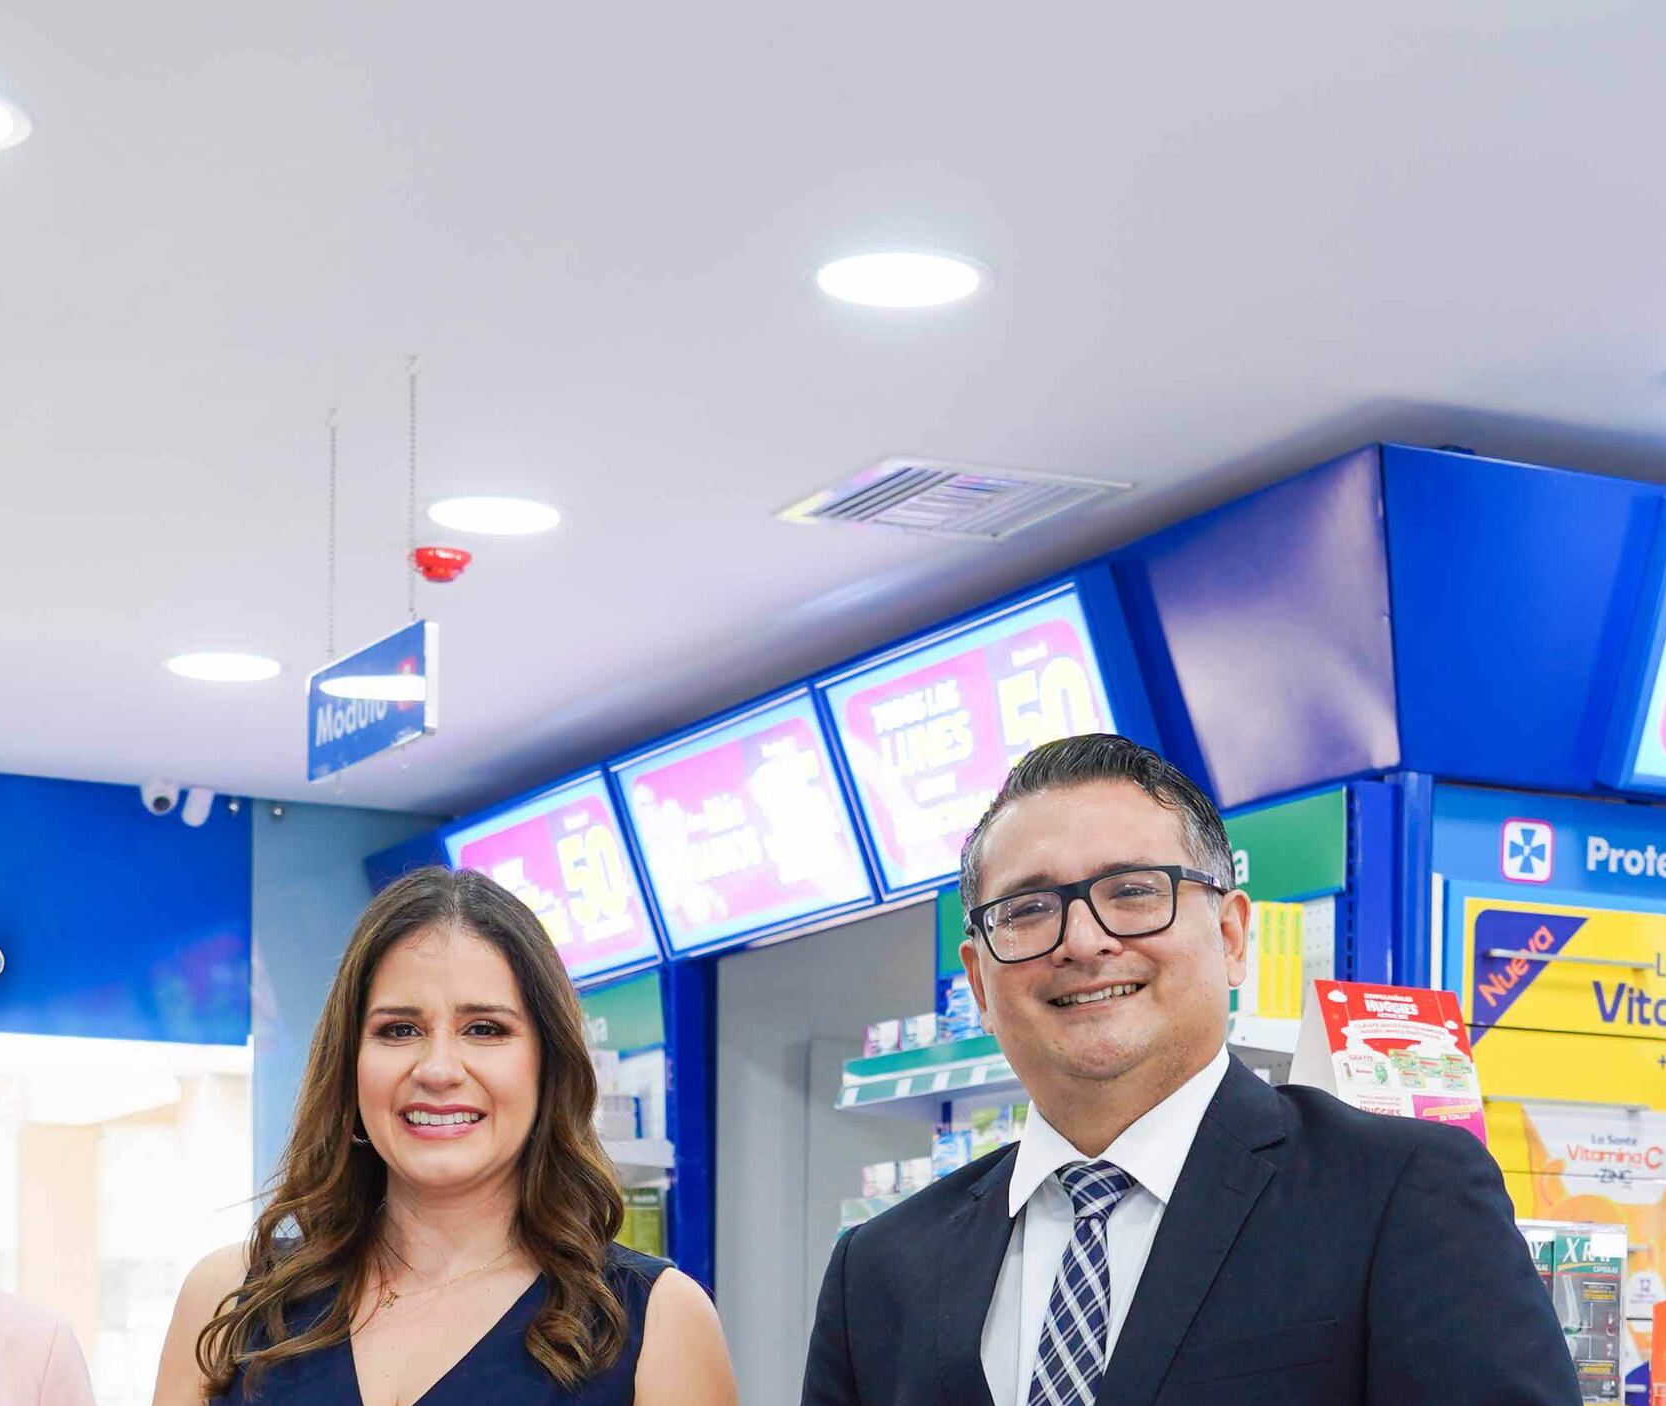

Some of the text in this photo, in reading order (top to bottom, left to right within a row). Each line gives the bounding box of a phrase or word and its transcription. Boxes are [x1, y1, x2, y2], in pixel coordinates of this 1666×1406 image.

[1478, 925, 1554, 1007] Nueva
[1364, 1000, 1419, 1015] HUGGIES
[1568, 1144, 1663, 1169] Vitamina C
